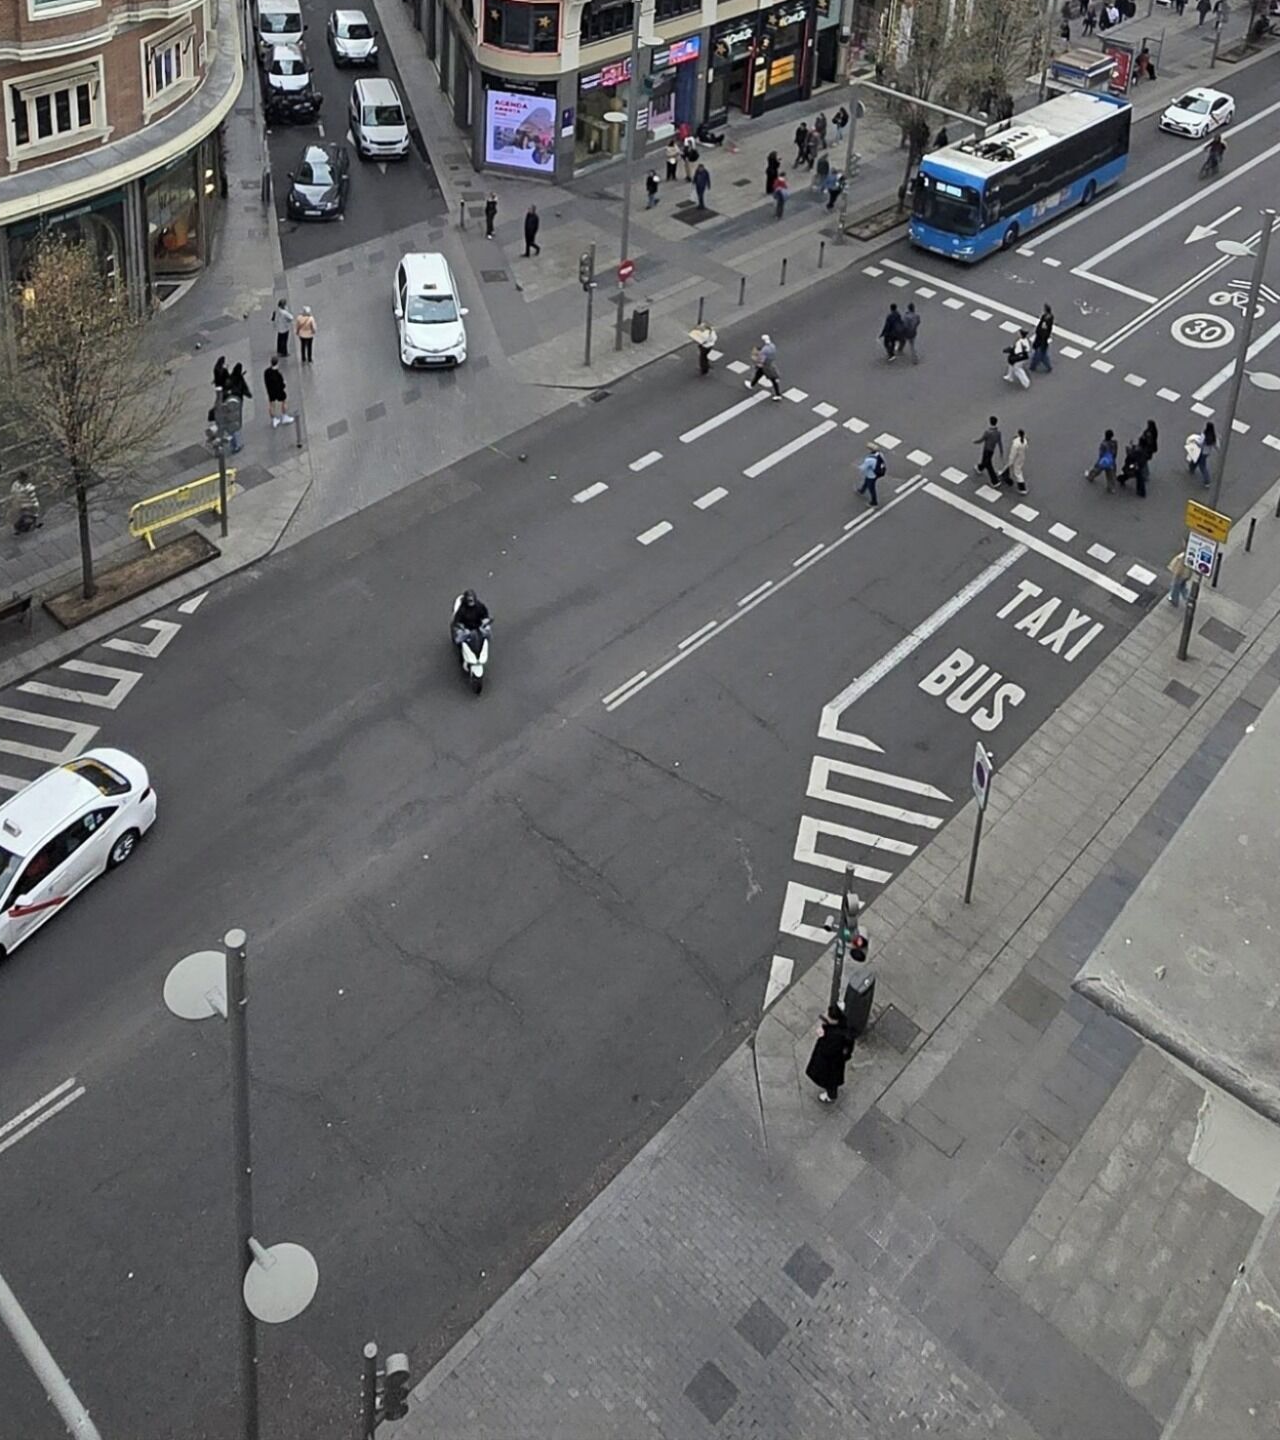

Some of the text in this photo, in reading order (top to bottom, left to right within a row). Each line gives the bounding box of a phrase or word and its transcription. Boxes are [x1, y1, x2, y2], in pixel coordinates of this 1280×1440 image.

[1184, 320, 1222, 341] 30
[996, 579, 1105, 662] TAXI
[918, 647, 1027, 732] BUS
